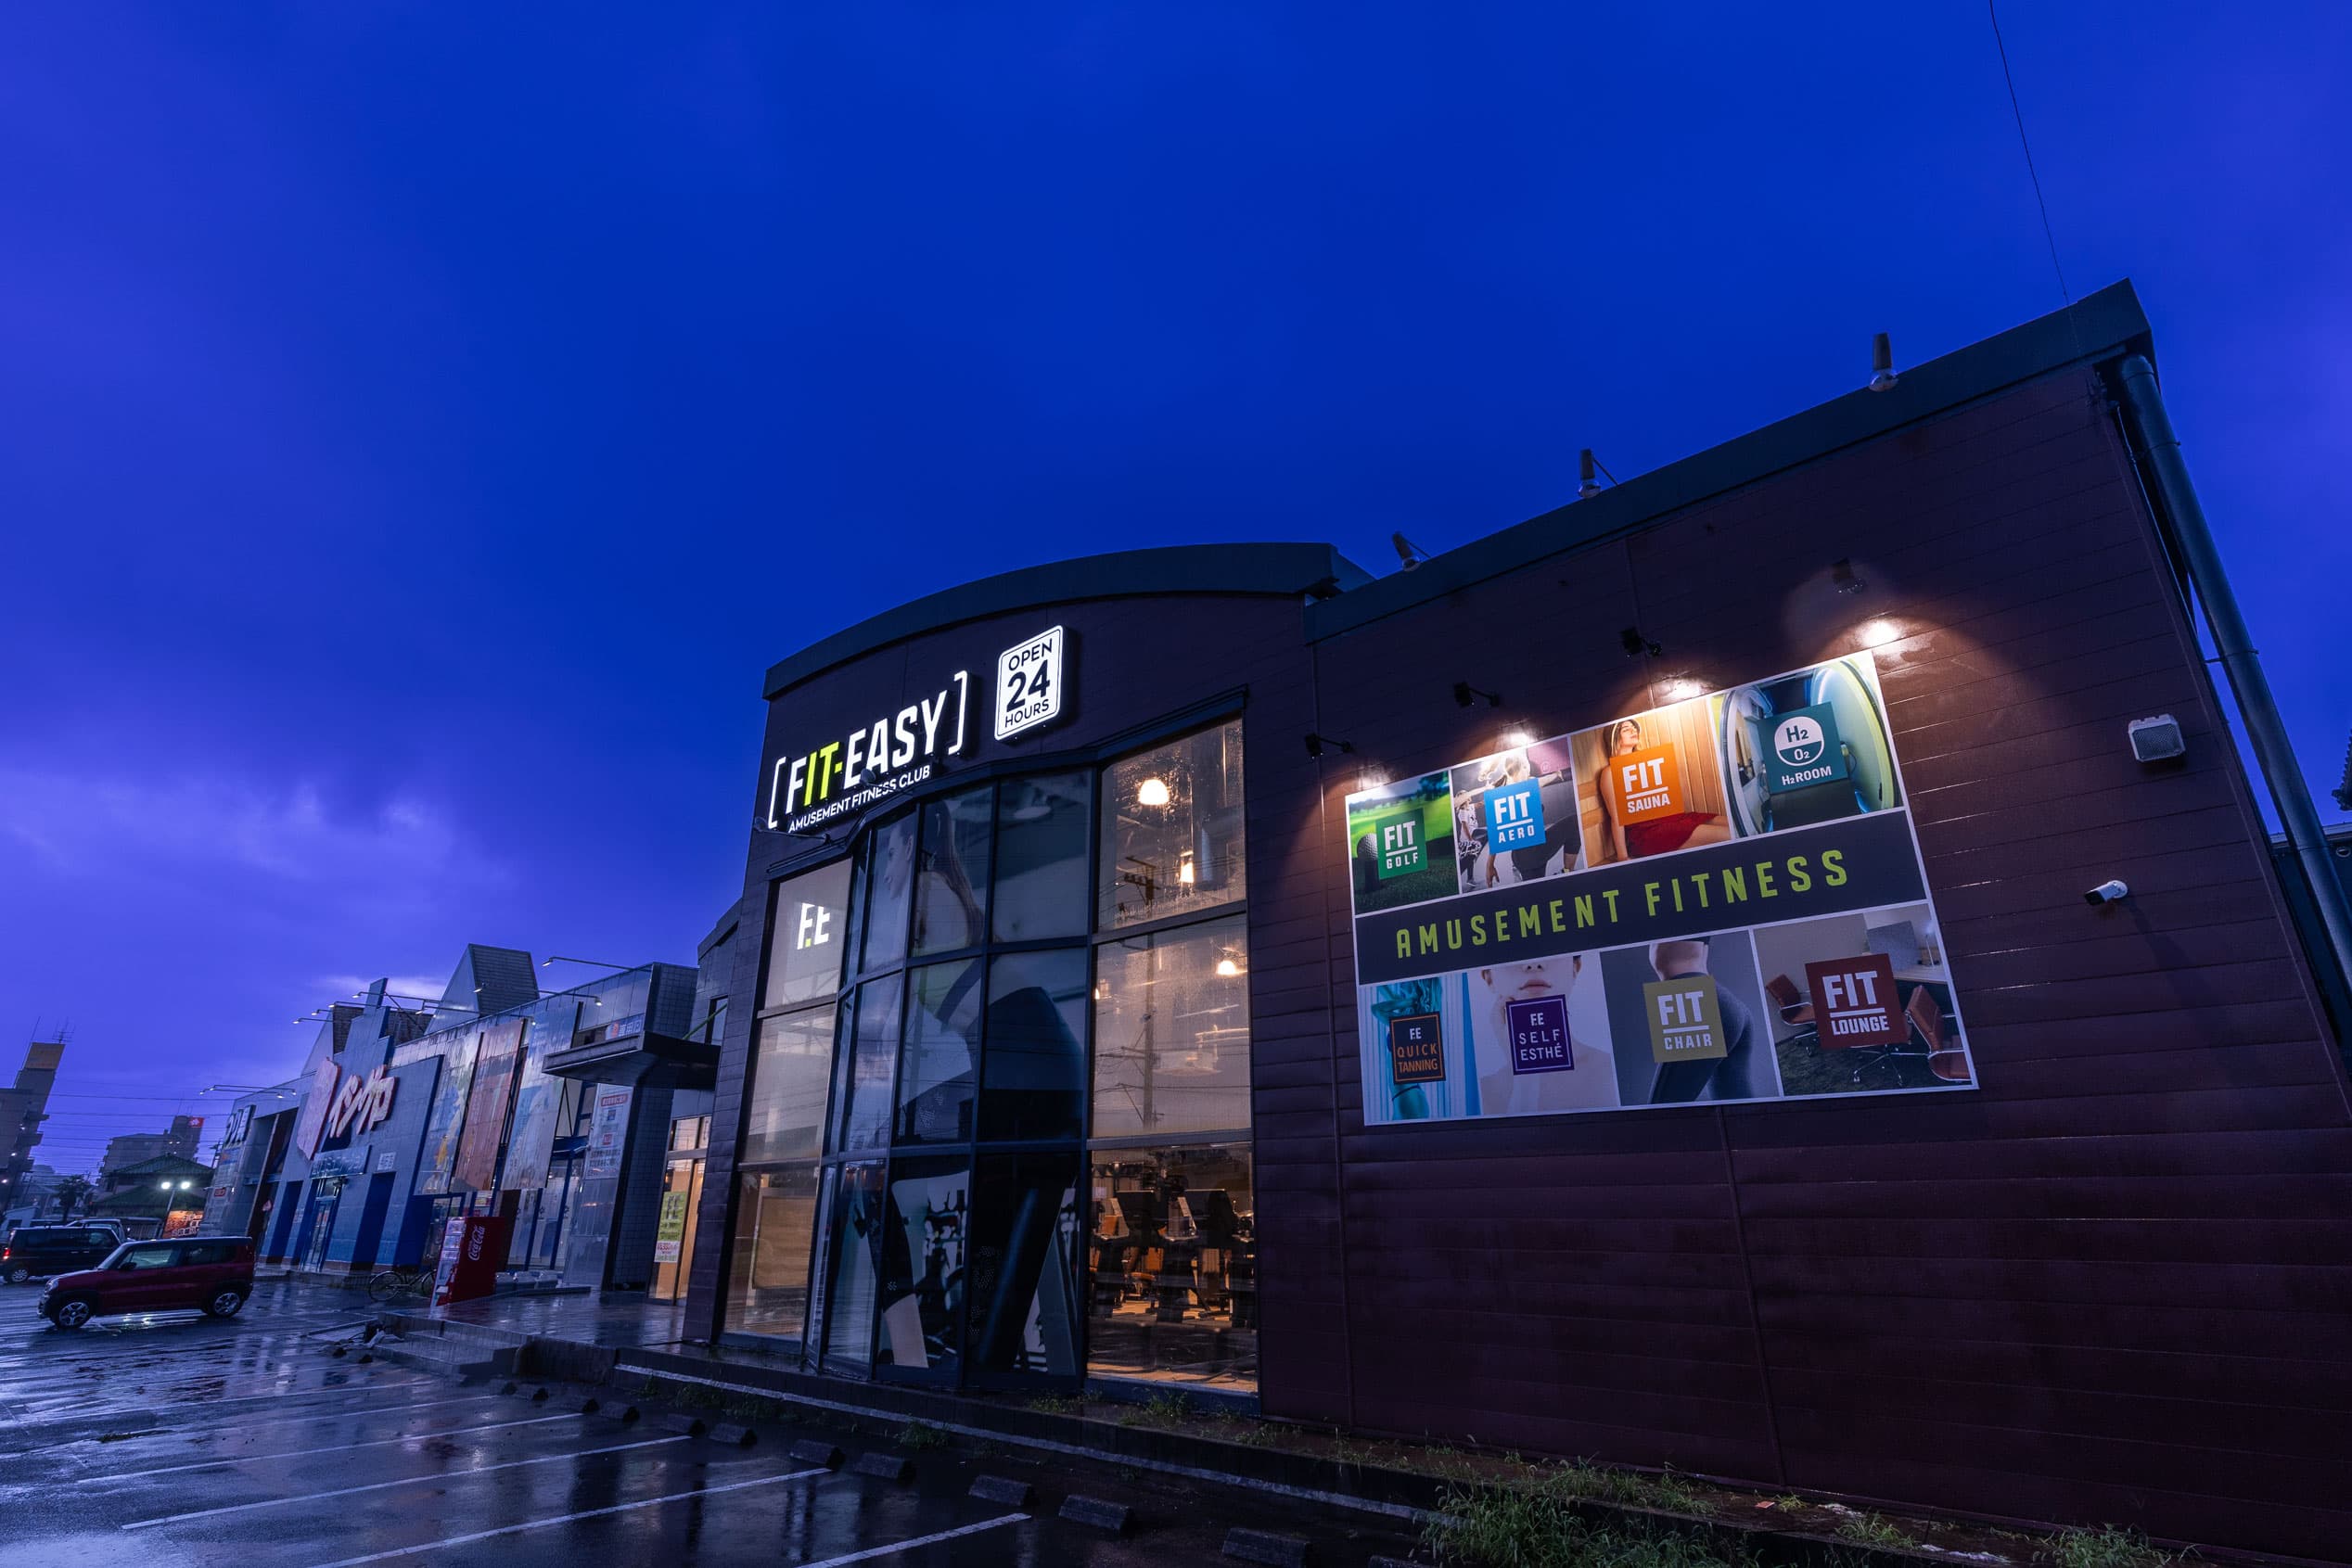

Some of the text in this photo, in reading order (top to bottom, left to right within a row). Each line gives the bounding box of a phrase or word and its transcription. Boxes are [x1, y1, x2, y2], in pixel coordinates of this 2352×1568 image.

[1008, 638, 1053, 671] OPEN
[1006, 659, 1051, 712] 24
[1004, 698, 1050, 728] HOURS
[1622, 758, 1665, 793] FIT
[788, 764, 931, 833] AMUSEMENT FITNESS CLUB
[1494, 791, 1530, 824] FIT
[1627, 794, 1670, 814] SAUNA
[1384, 820, 1416, 850] FIT
[1498, 824, 1535, 844] AERO
[1386, 853, 1419, 869] GOLF
[1396, 849, 1848, 959] AMUSEMENT FITNESS
[1822, 970, 1878, 1009] FIT
[1657, 990, 1704, 1026] FIT
[1519, 1028, 1560, 1045] SELF
[1831, 1015, 1890, 1036] LOUNGE
[1397, 1042, 1438, 1057] QUICK
[1520, 1042, 1563, 1061] ESTHÉ
[1664, 1032, 1713, 1051] CHAIR
[1399, 1058, 1438, 1073] TANNING
